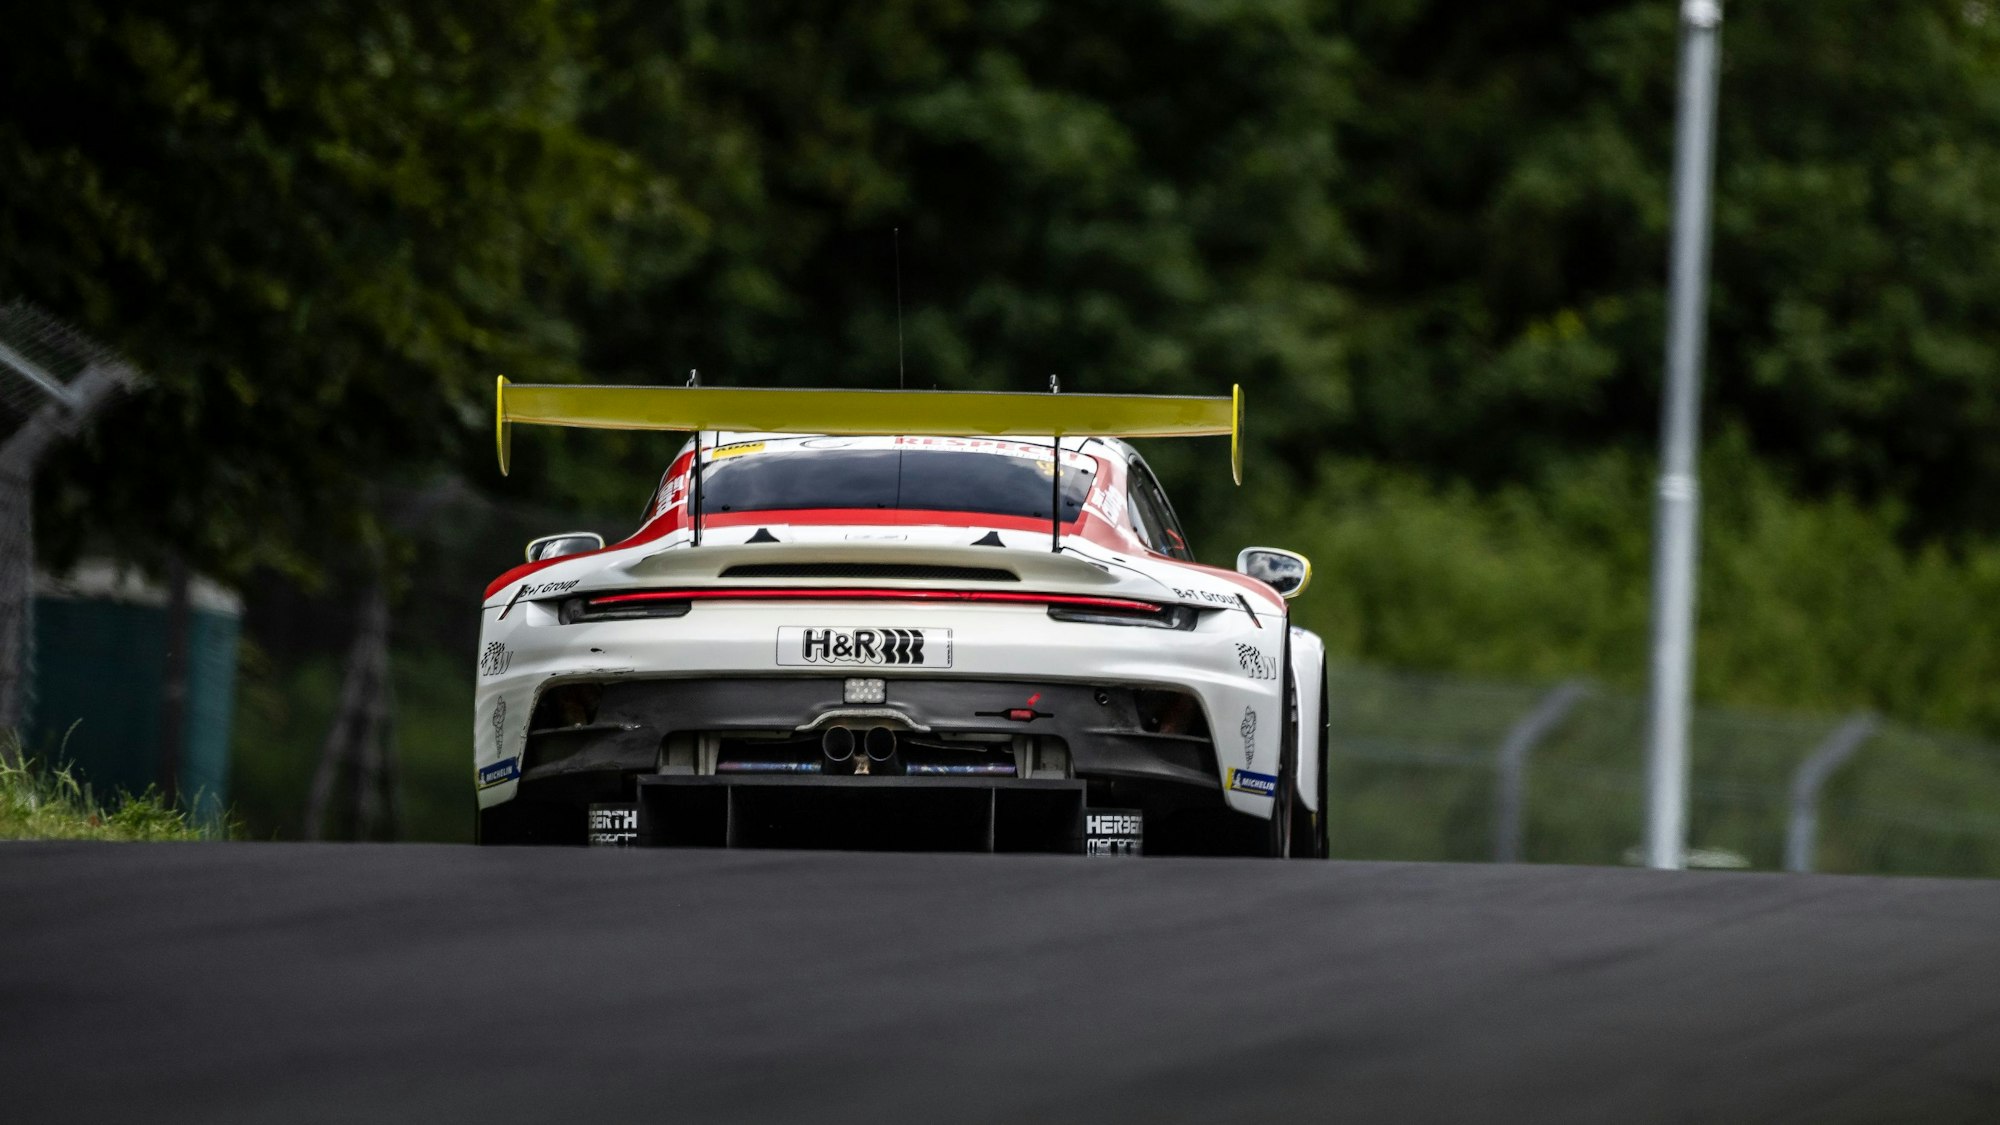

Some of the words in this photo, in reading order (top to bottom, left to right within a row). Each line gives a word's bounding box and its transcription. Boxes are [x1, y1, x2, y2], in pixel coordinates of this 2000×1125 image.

[542, 579, 580, 592] Group
[803, 628, 883, 664] H&R
[486, 765, 513, 782] MICHELIN
[1241, 776, 1275, 792] MICHELIN
